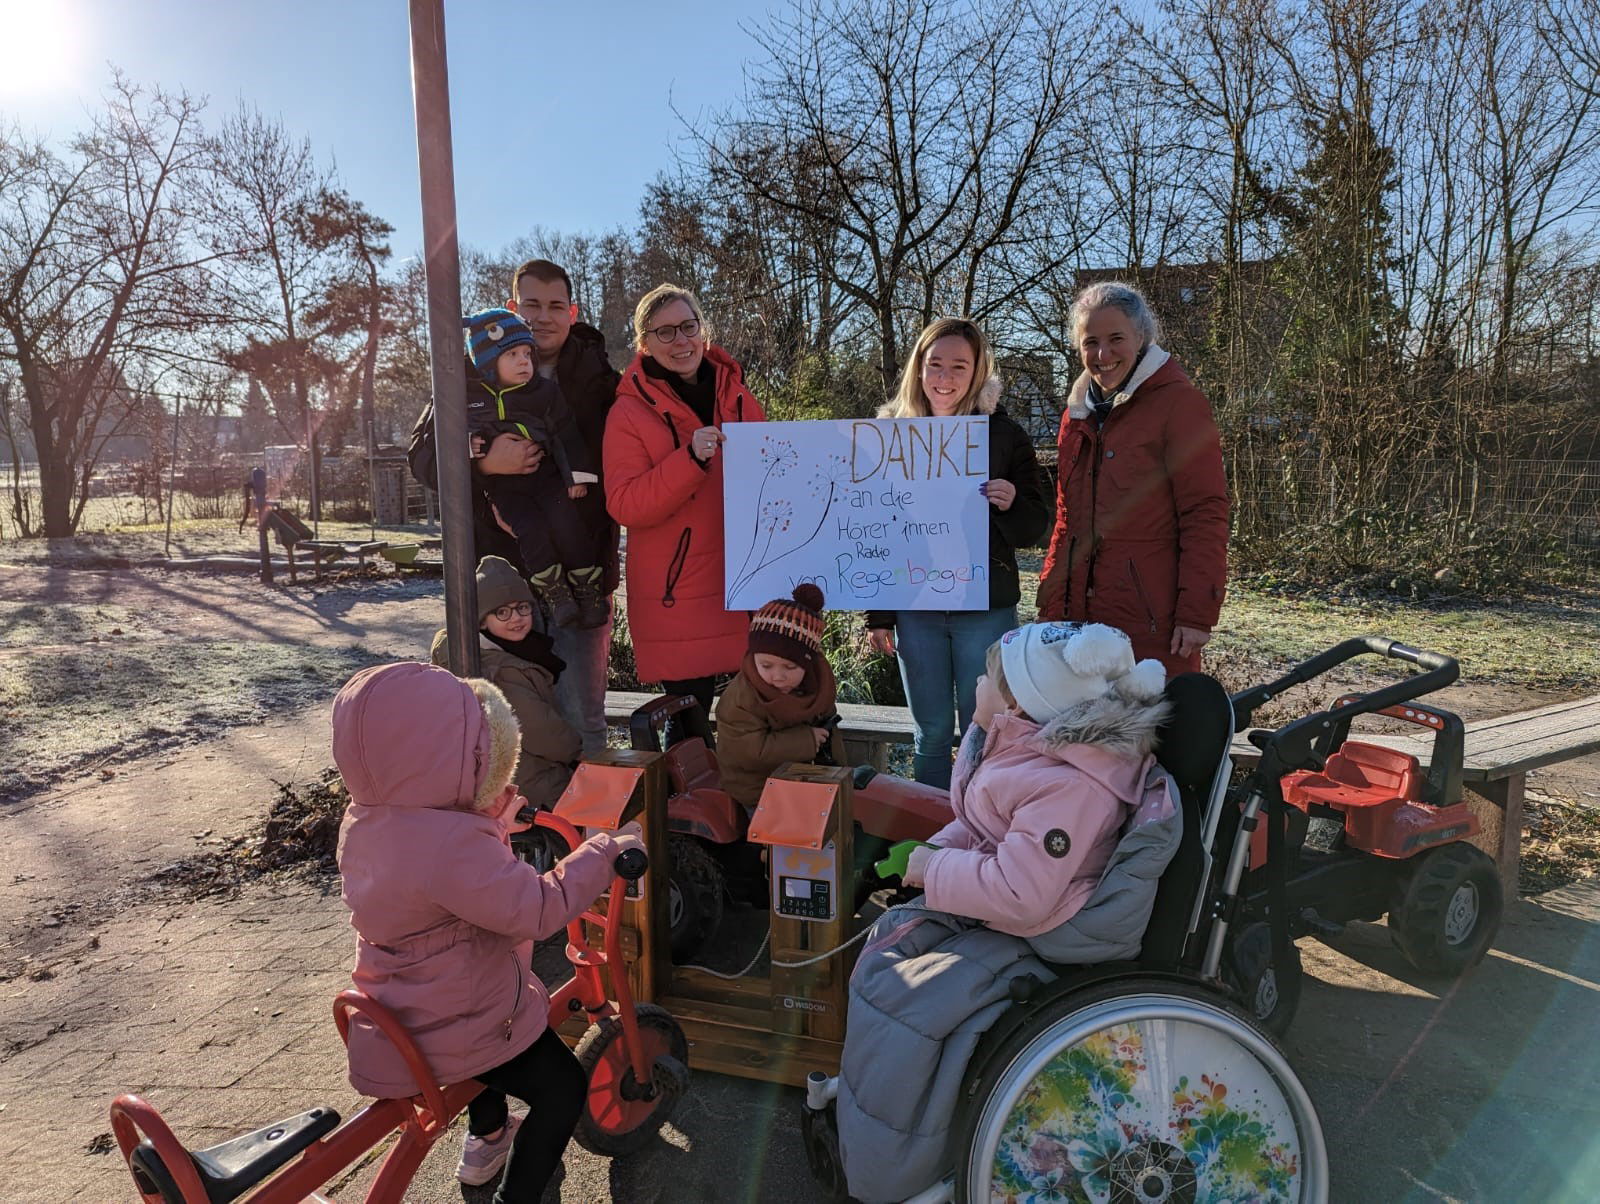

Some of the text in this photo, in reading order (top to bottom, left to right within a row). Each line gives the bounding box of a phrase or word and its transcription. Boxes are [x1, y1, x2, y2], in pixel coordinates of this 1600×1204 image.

[851, 421, 987, 483] DANKE
[850, 482, 915, 511] an die
[857, 542, 890, 562] Radio
